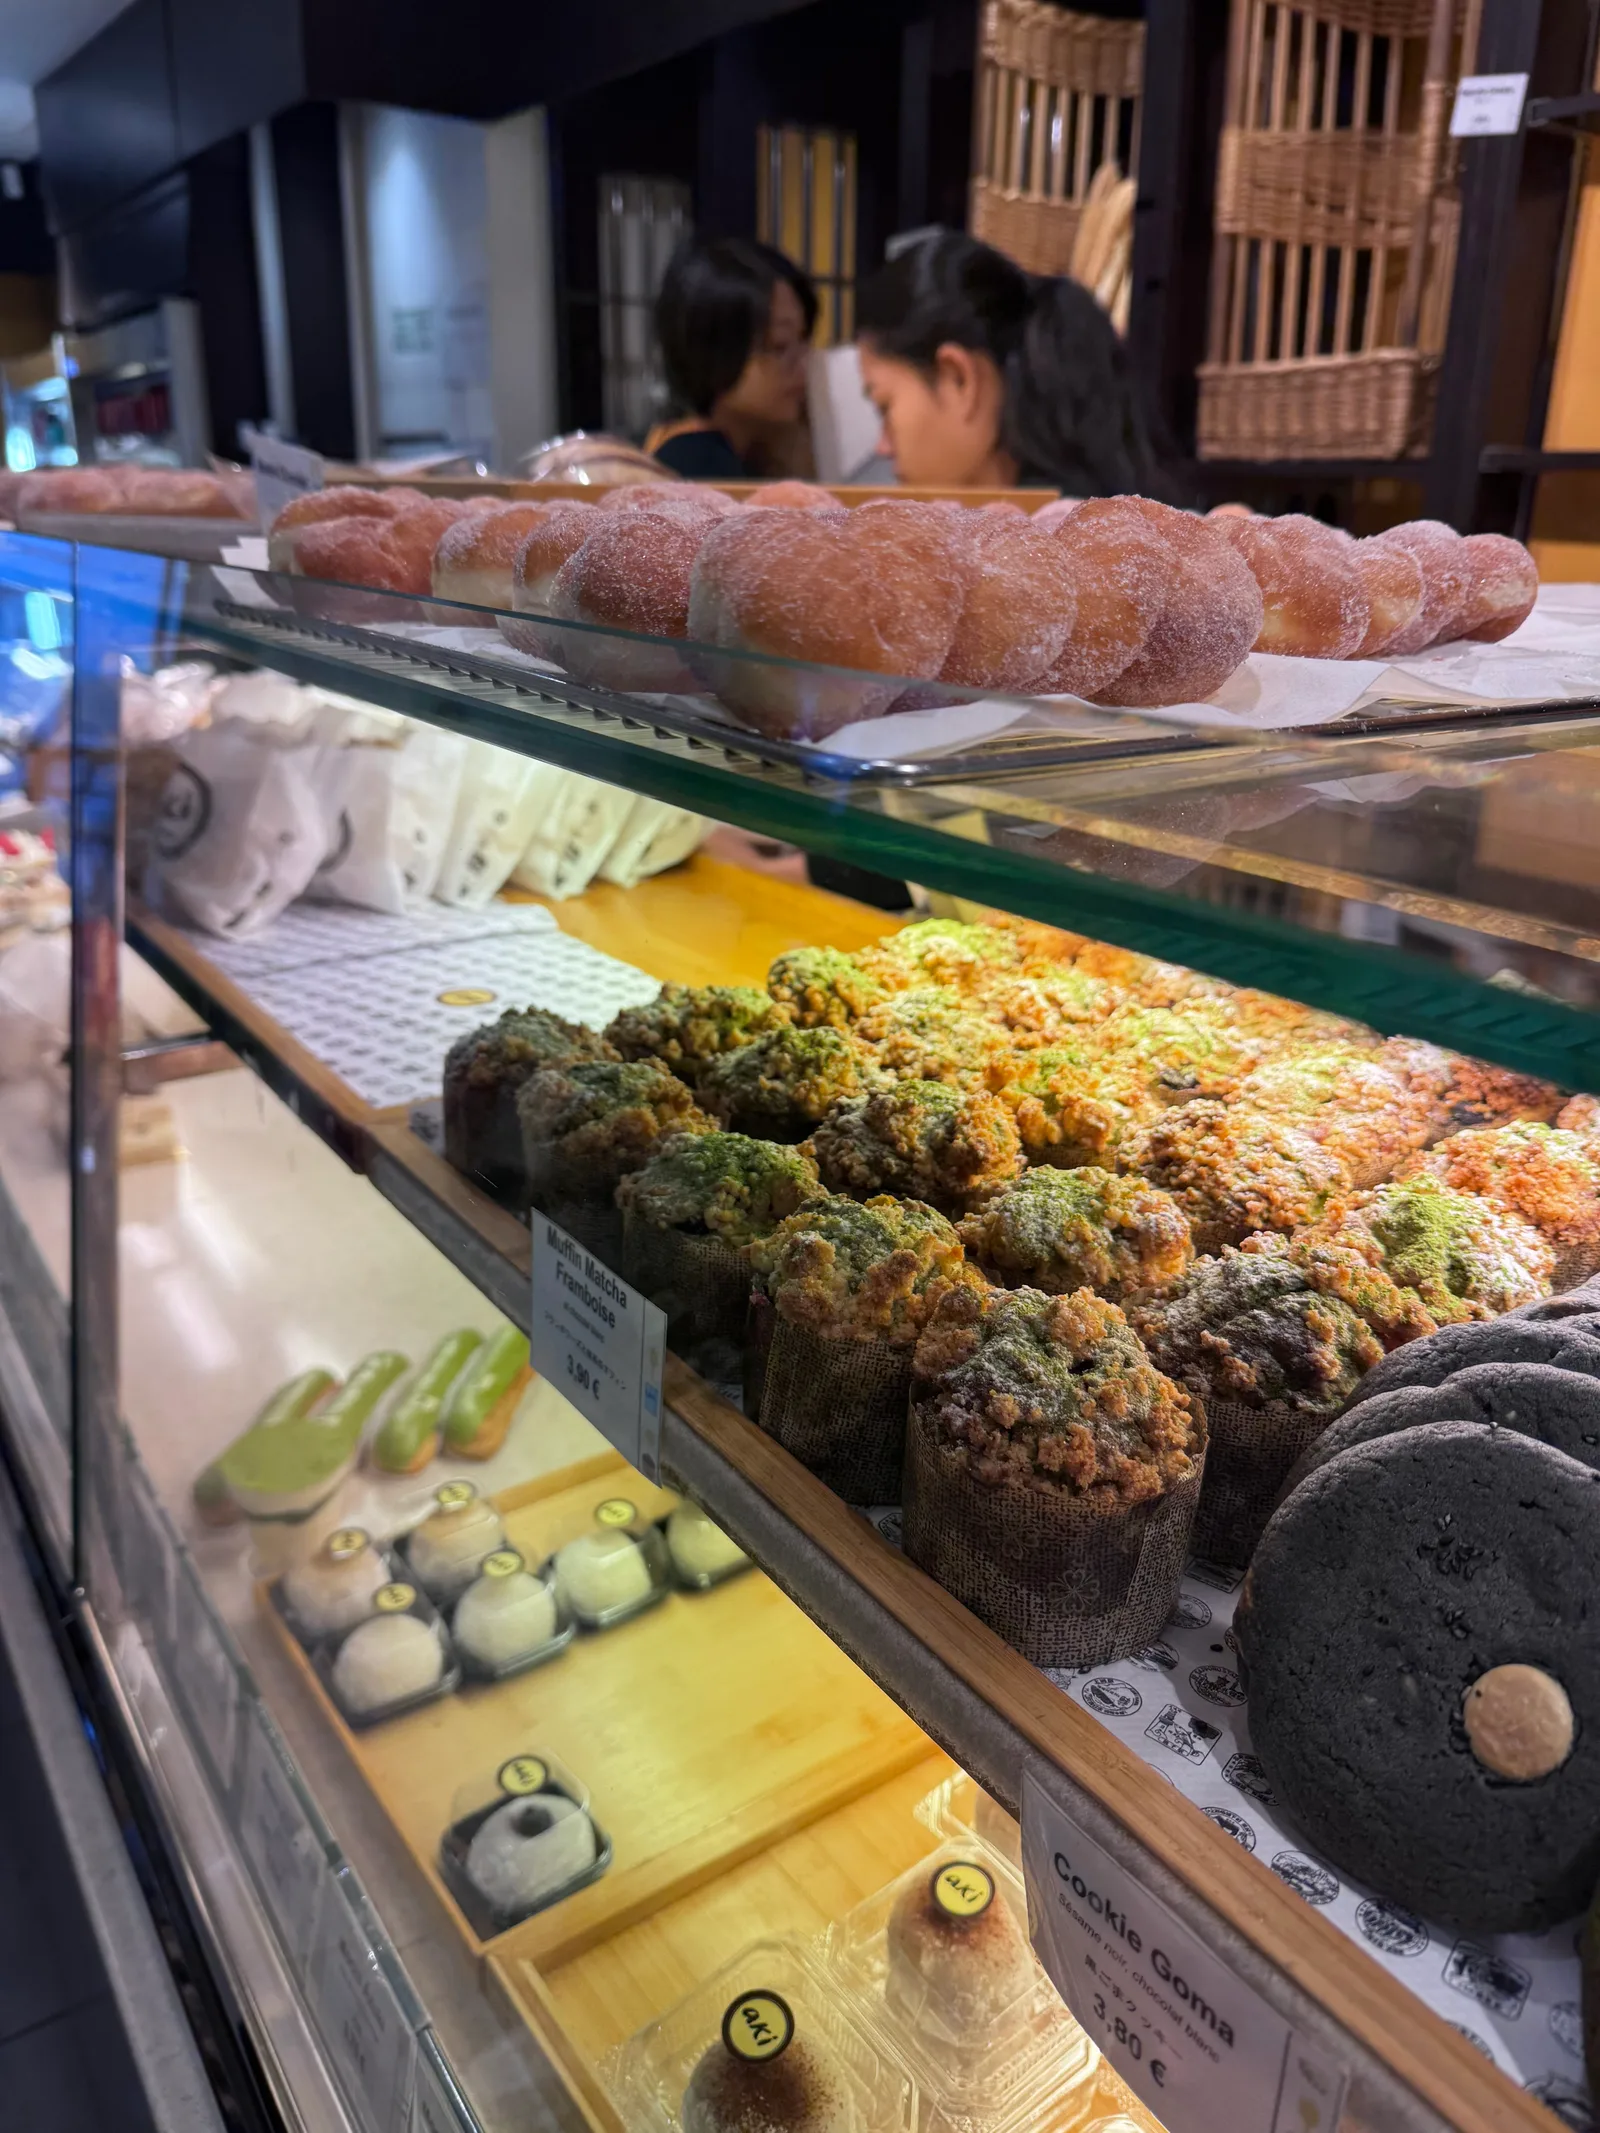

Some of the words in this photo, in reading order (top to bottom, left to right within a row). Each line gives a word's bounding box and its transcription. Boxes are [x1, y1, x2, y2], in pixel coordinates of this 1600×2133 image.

[547, 1224, 582, 1271] Muffin
[585, 1256, 627, 1309] Matcha
[556, 1260, 616, 1328] Framboise
[567, 1353, 590, 1390] 3,90
[592, 1378, 600, 1400] €
[1054, 1852, 1142, 1954] Cookie
[1151, 1948, 1235, 2049] Goma
[1058, 1892, 1102, 1944] Sésame
[1103, 1942, 1128, 1974] noir,
[1132, 1970, 1183, 2027] chocolat
[1093, 1993, 1142, 2061] 3,80
[1150, 2058, 1167, 2088] €
